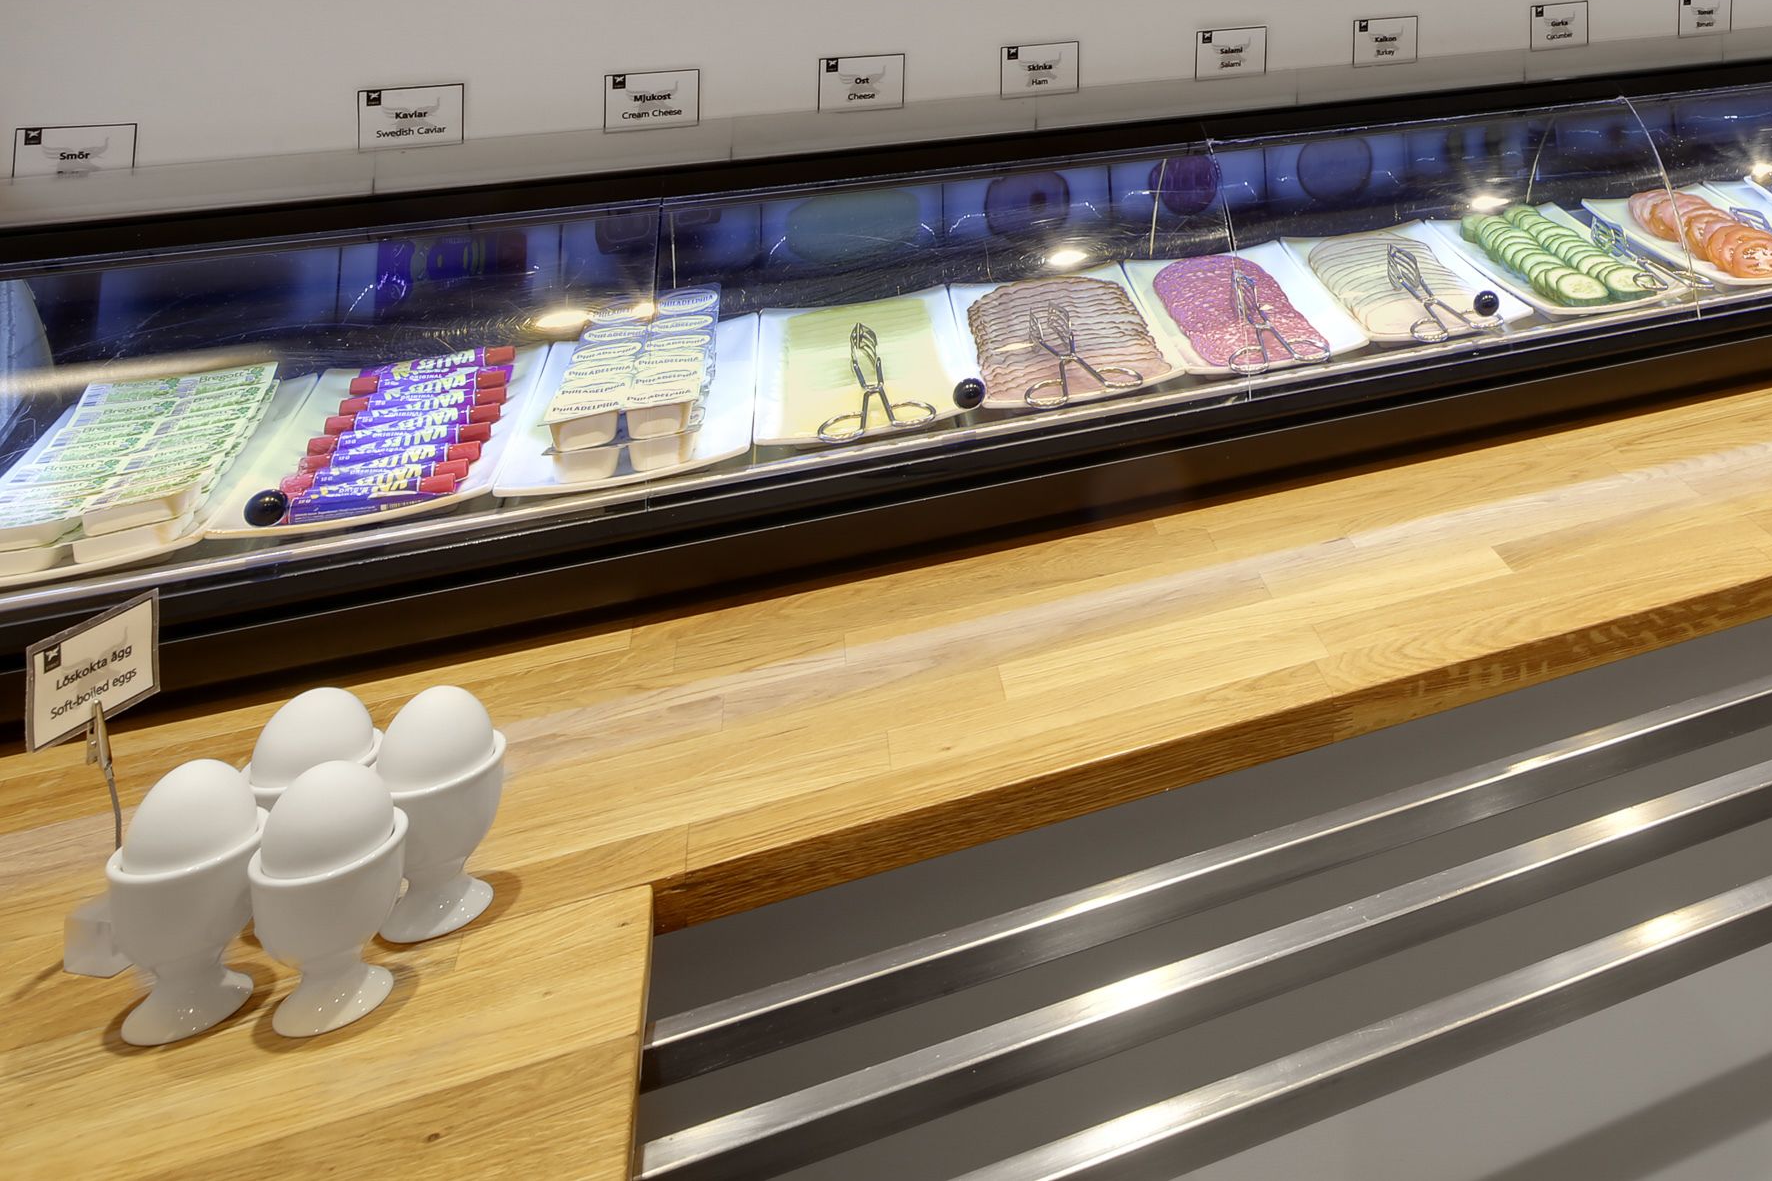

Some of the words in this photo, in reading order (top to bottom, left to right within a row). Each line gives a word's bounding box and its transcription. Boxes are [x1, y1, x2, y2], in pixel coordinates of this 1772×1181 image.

[1374, 35, 1397, 43] Kalkon
[1546, 31, 1573, 40] Cucumber
[1220, 46, 1243, 55] Salami
[1376, 49, 1395, 57] Turkey
[1027, 63, 1053, 72] Skinka
[1220, 60, 1242, 68] Salami
[854, 77, 870, 85] Ost
[1032, 78, 1049, 86] Ham
[633, 92, 672, 103] Mjukost
[847, 92, 876, 101] Cheese
[395, 110, 428, 120] Kaviar
[621, 111, 650, 119] Cream
[651, 108, 683, 117] Cheese
[376, 128, 414, 138] Swedish
[417, 125, 446, 135] Caviar
[59, 151, 91, 160] Smör
[659, 294, 714, 308] PHILADELPHIA
[638, 356, 699, 366] PHILADELPHIA
[568, 365, 631, 377] PHILADELPHIA
[199, 371, 245, 383] Bregott
[561, 382, 626, 395] PHILADELPHIA
[102, 404, 153, 415] Bregott
[552, 401, 619, 412] PHILADELPHIA
[82, 423, 136, 434] Bregott
[55, 658, 108, 691] Löskokta
[50, 679, 109, 720] Soft-boiled
[111, 667, 137, 687] eggs
